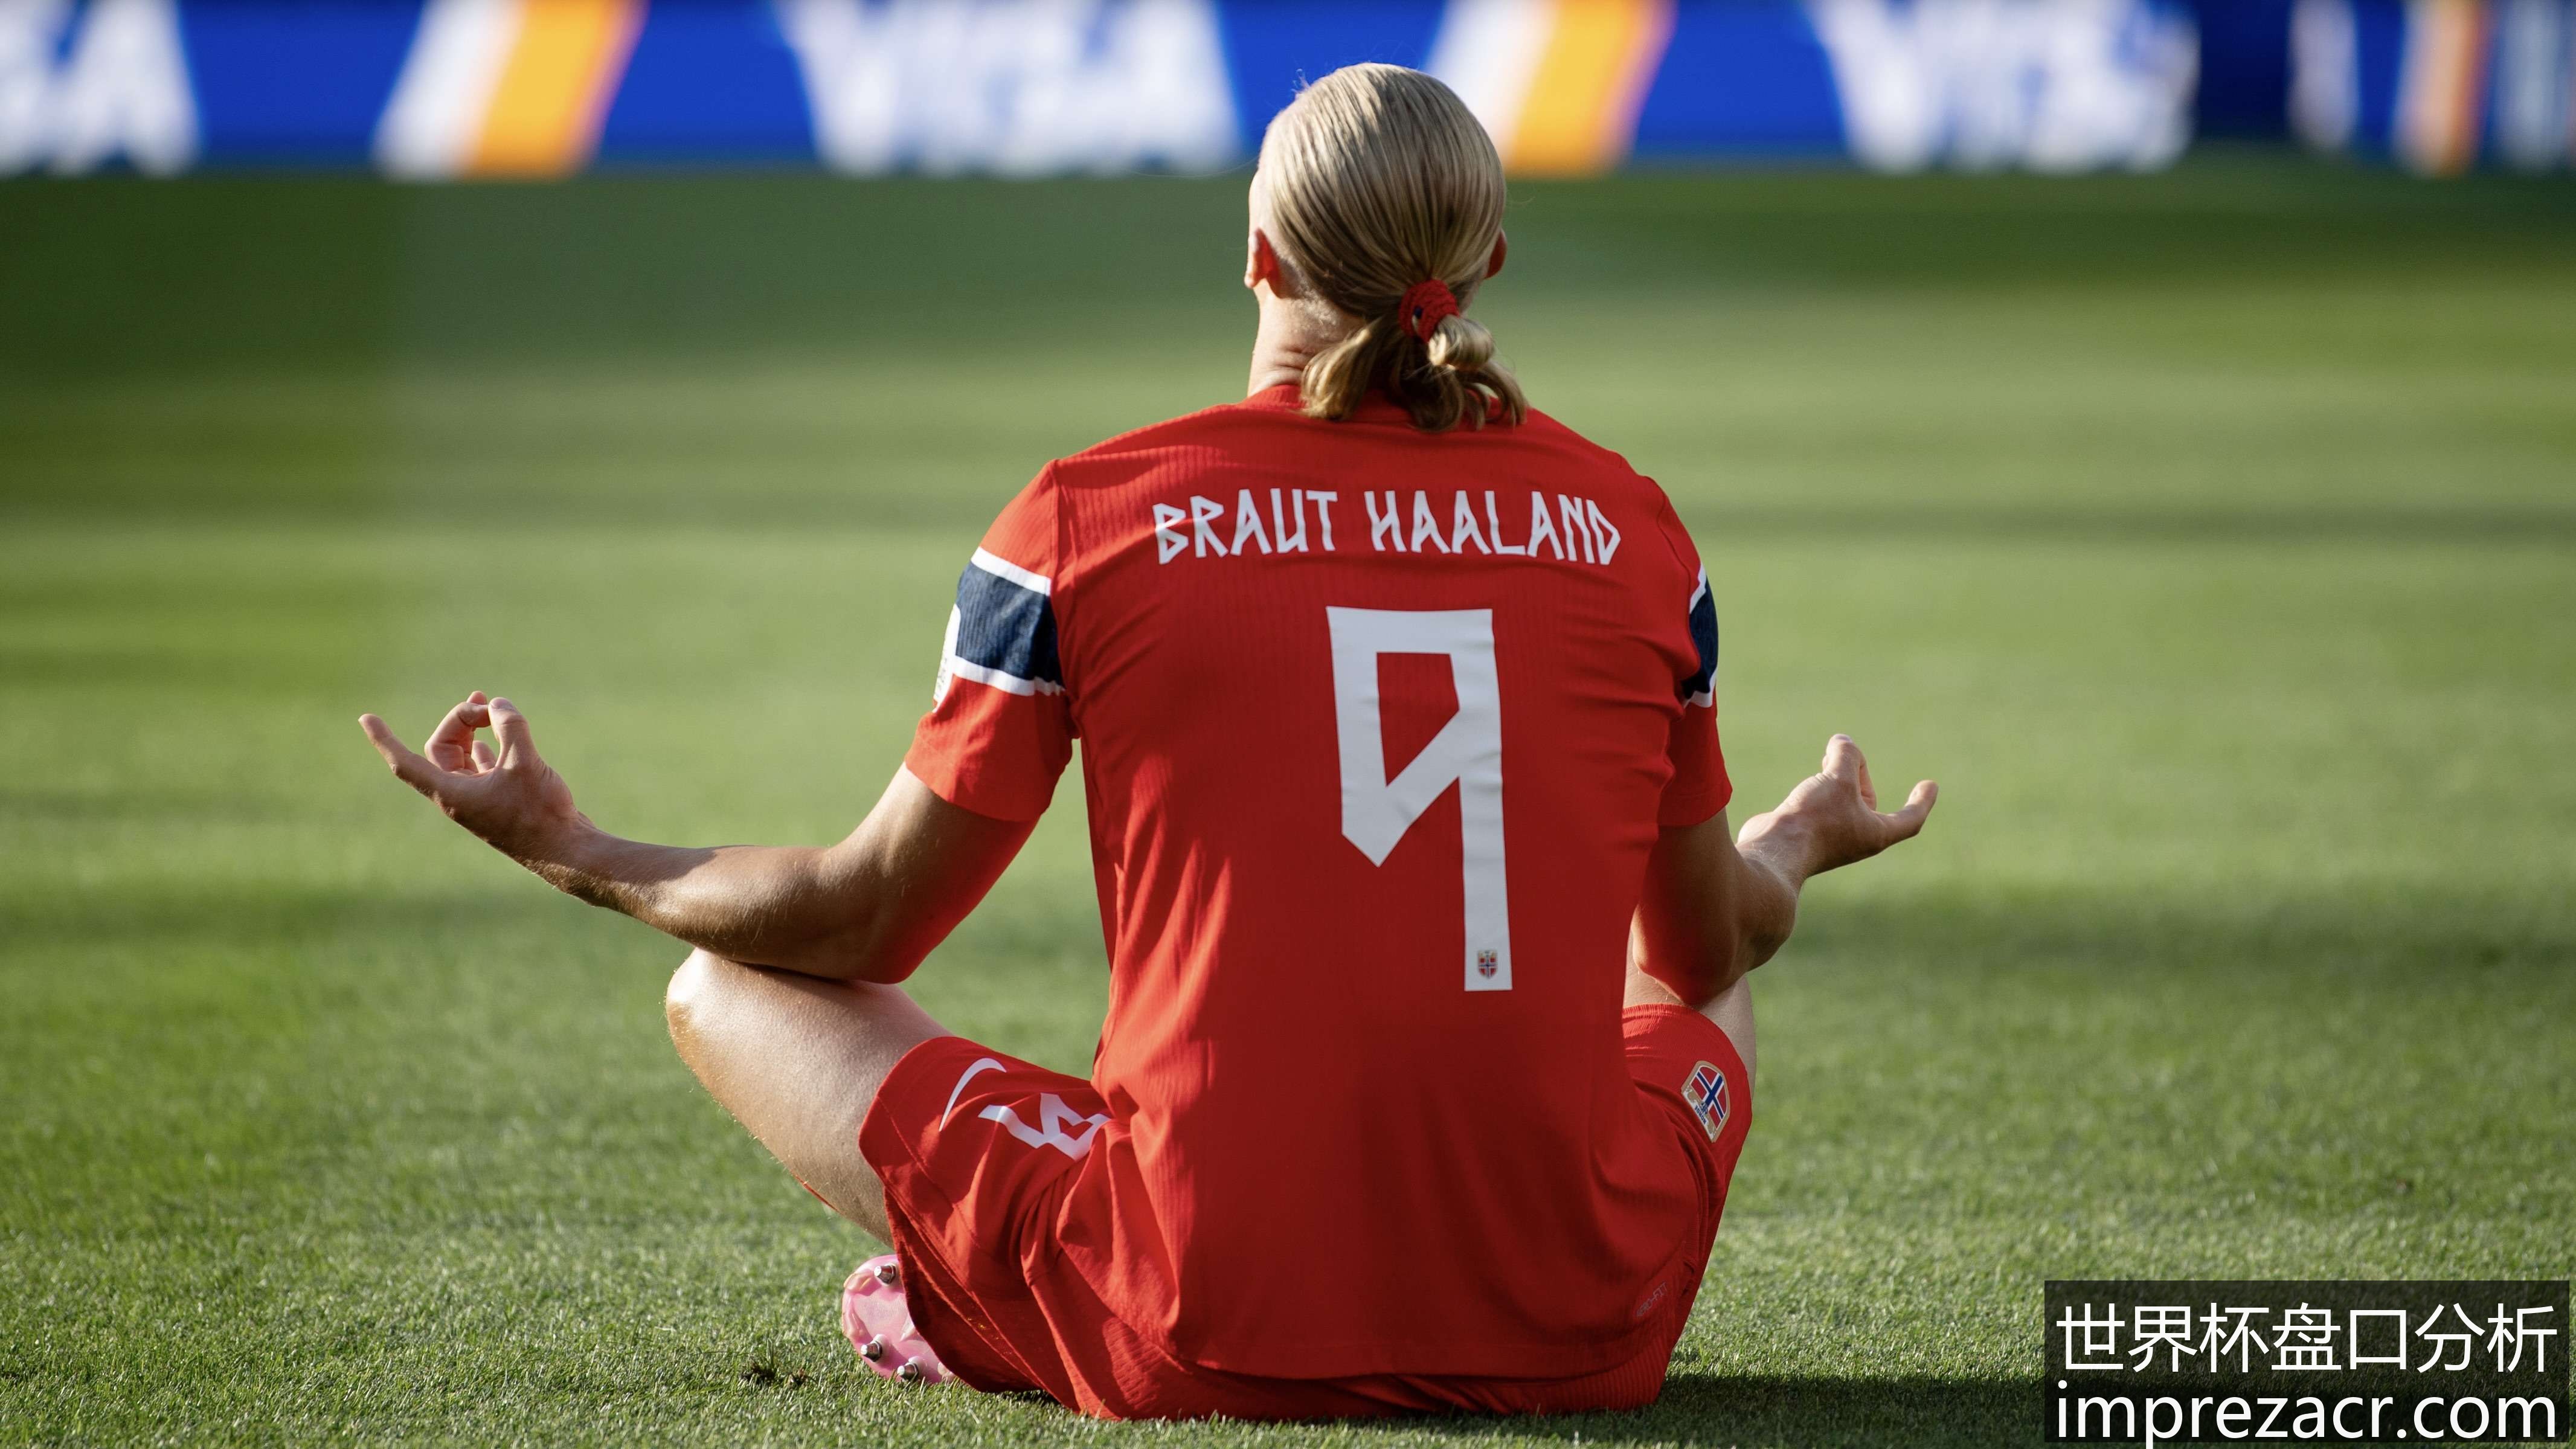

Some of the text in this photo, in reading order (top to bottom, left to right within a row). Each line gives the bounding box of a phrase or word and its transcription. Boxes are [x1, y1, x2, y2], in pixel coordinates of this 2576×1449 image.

[1152, 488, 1621, 565] BRAUT HAALAND
[1326, 606, 1512, 991] 9
